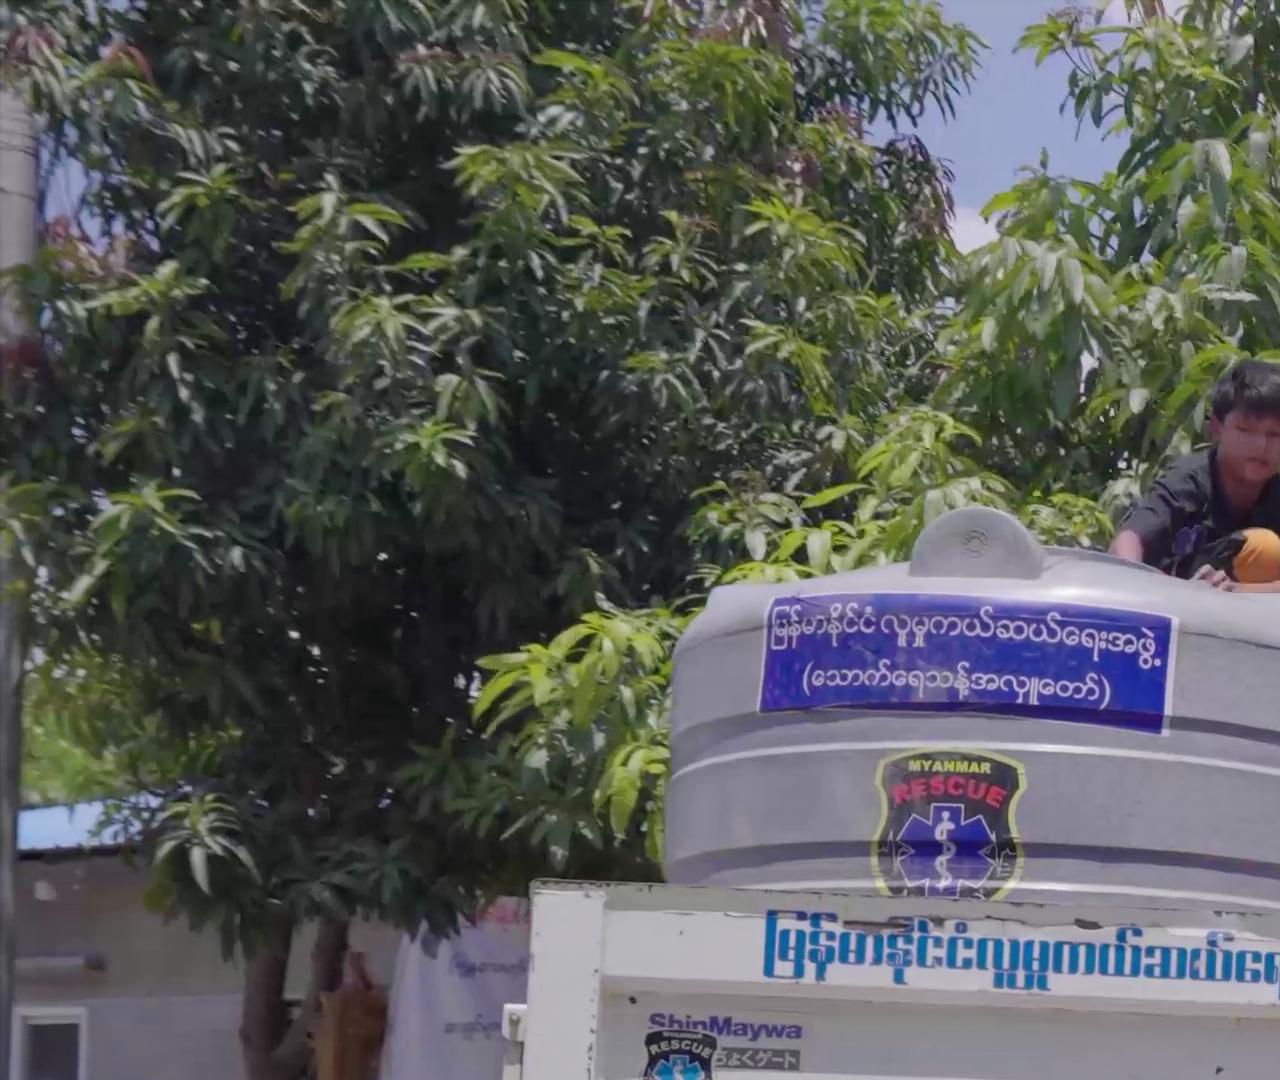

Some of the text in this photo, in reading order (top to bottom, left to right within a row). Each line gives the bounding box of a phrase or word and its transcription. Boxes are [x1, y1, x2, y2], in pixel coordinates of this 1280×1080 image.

[908, 760, 991, 774] MYANMAR
[891, 774, 1007, 808] RESCUE
[648, 1012, 803, 1041] ShinMaywa
[650, 1040, 713, 1059] RESCUE
